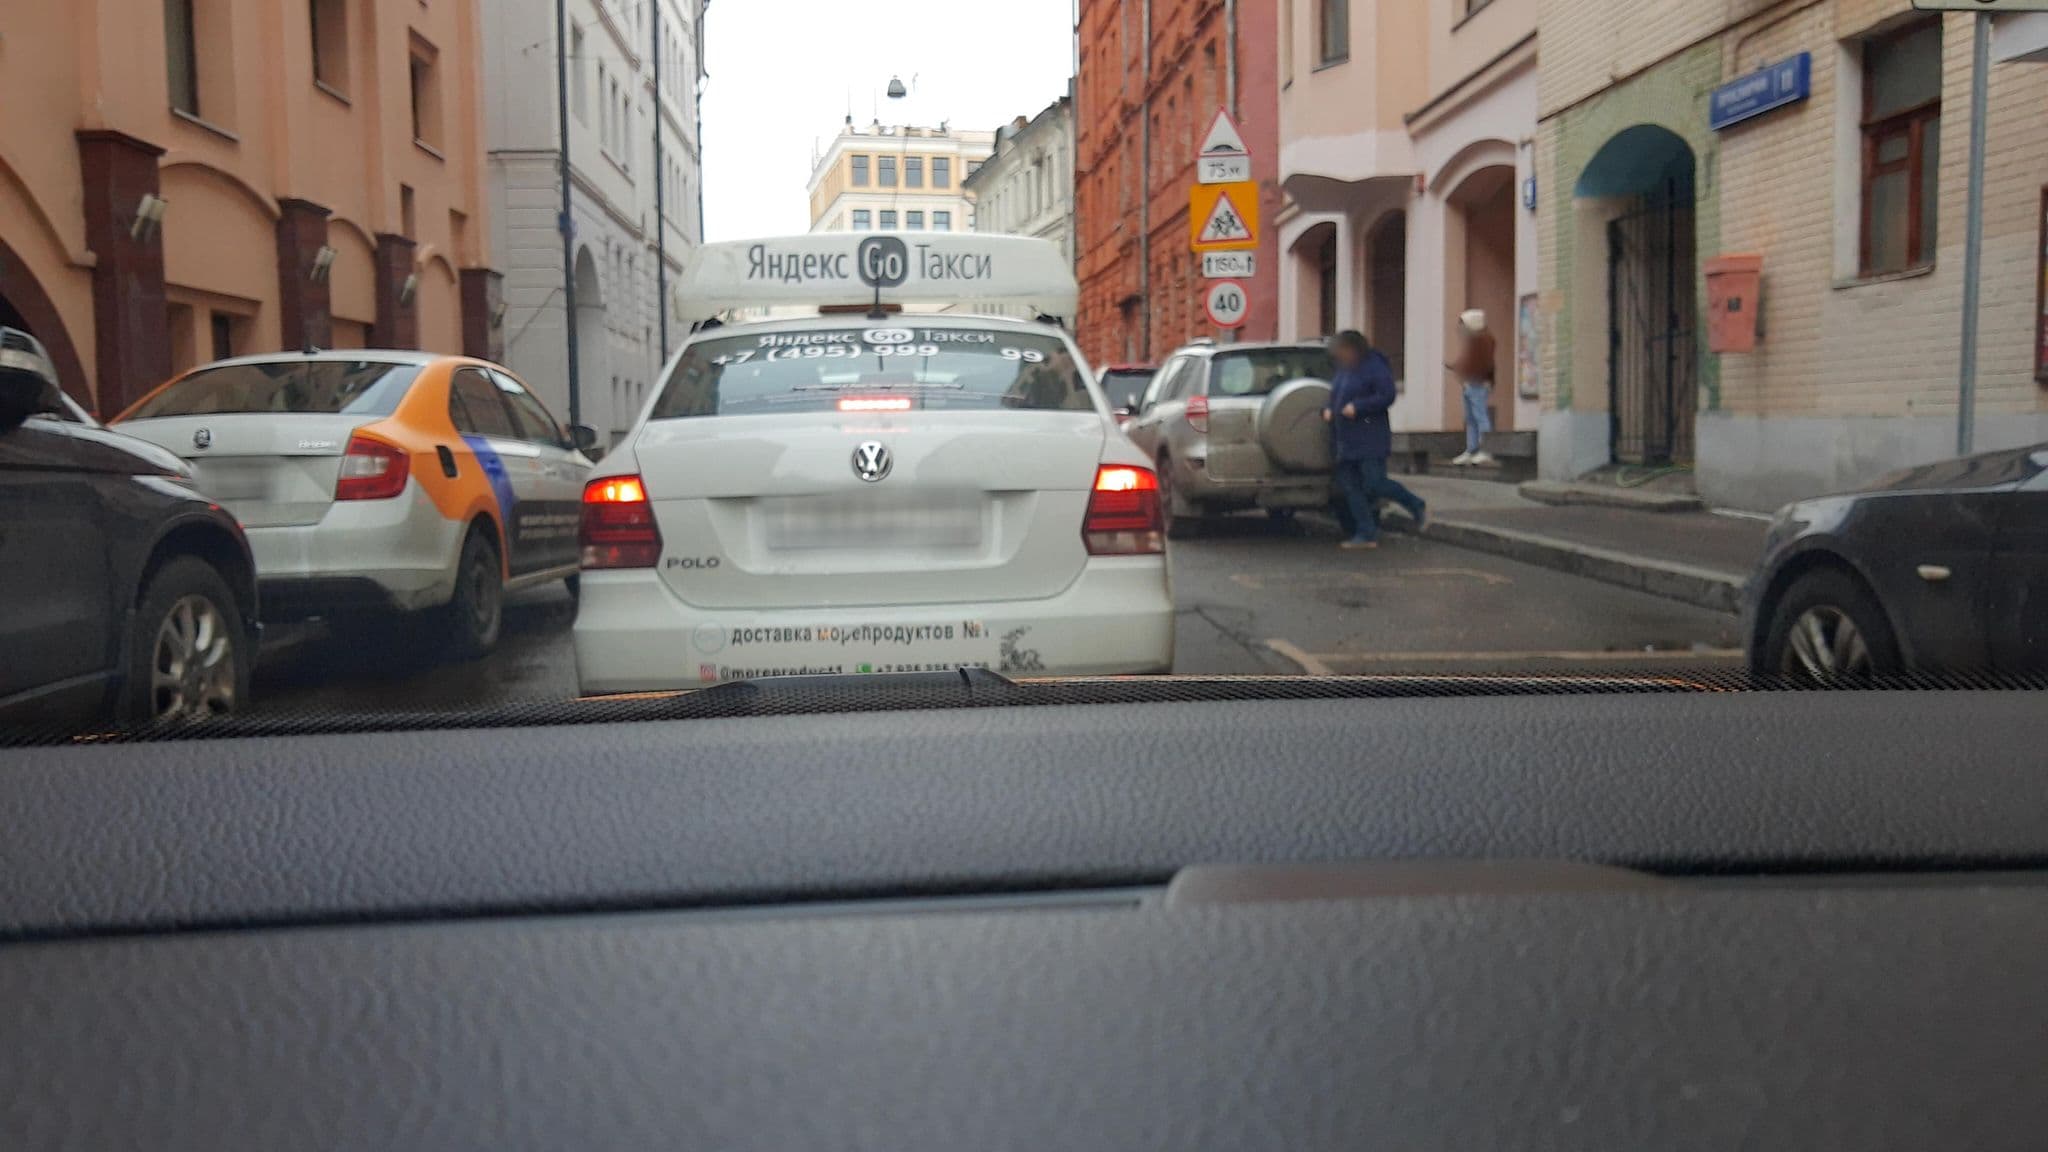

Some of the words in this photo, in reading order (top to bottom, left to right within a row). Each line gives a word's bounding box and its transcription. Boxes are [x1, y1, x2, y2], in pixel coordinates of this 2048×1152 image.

[748, 244, 849, 283] Яндекс
[861, 243, 903, 280] Go
[915, 244, 992, 280] Такси
[1214, 293, 1240, 312] 40
[758, 333, 856, 348] Яндекс
[871, 331, 906, 342] Go
[920, 330, 995, 344] Такси
[711, 350, 756, 366] +7
[766, 344, 862, 363] (495)
[873, 344, 939, 357] 999
[1000, 347, 1044, 363] 99
[666, 556, 720, 569] POLO
[732, 627, 813, 645] доставка
